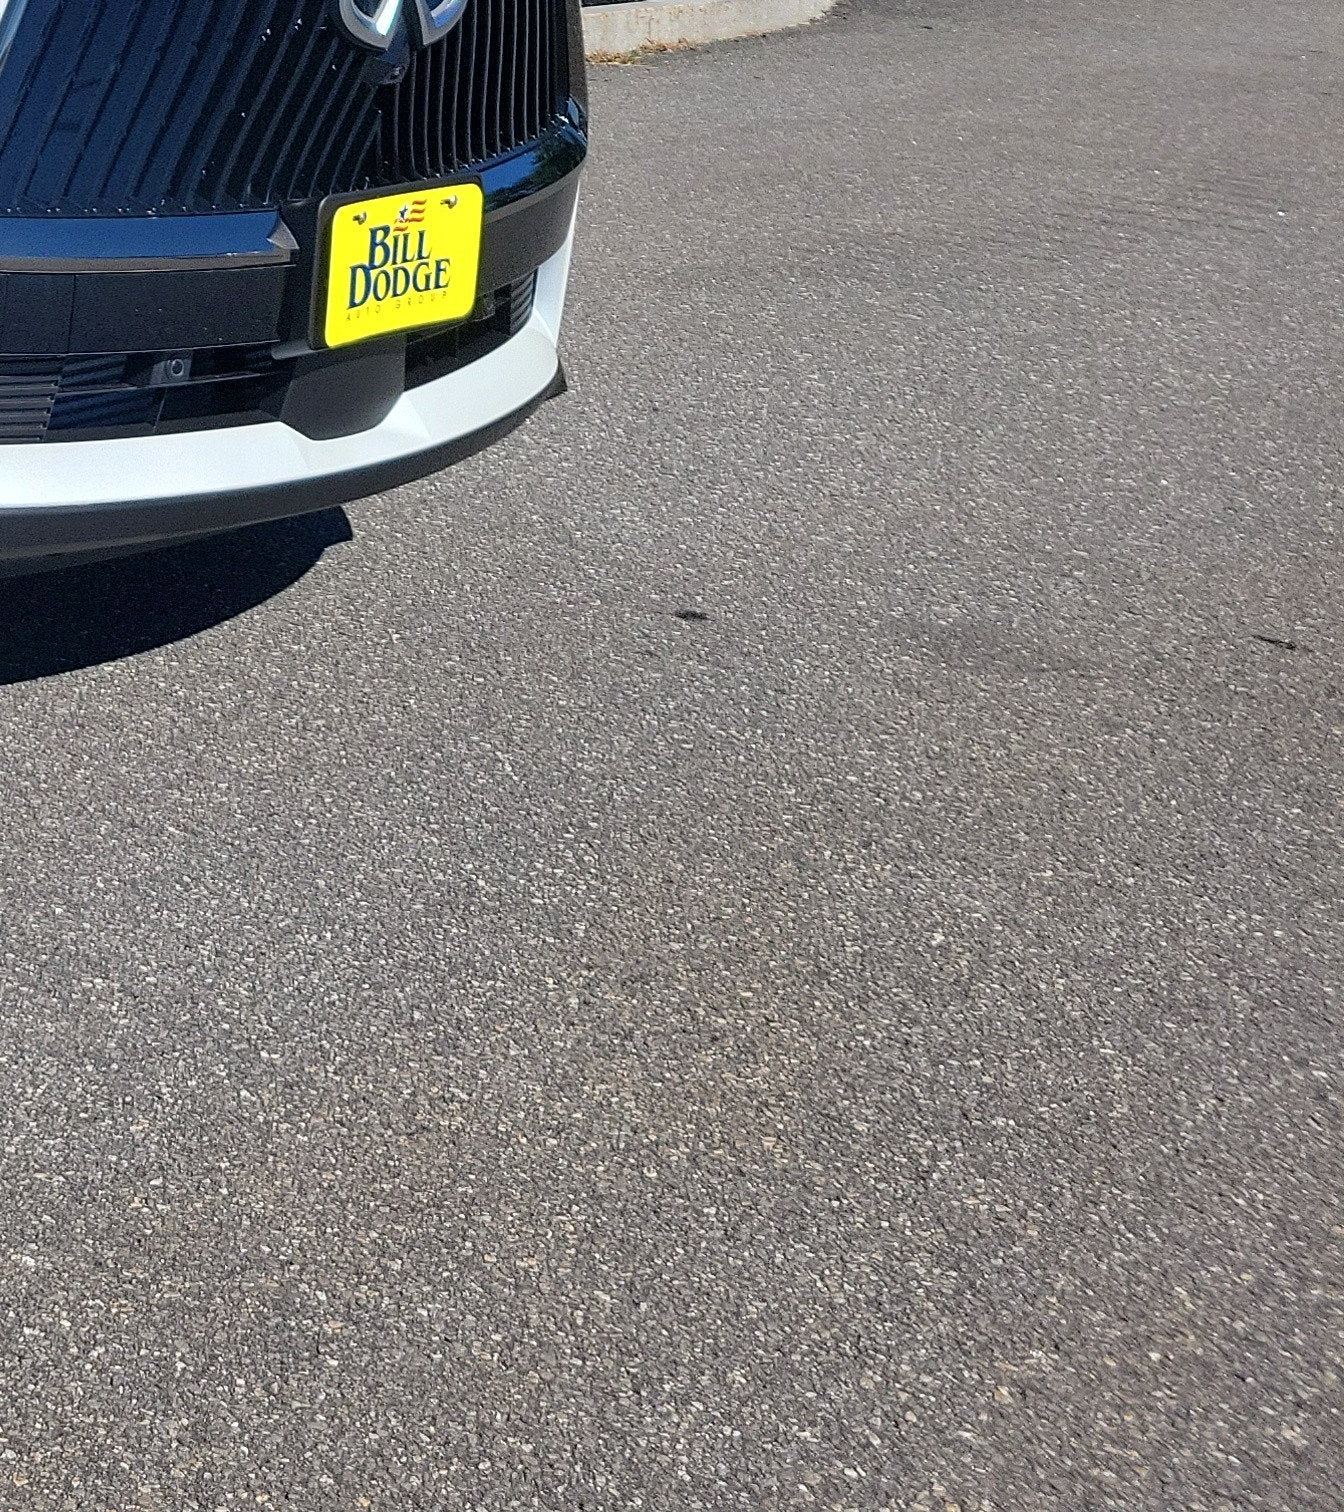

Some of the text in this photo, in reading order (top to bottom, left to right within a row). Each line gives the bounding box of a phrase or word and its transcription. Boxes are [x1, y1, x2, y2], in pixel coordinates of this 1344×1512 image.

[367, 223, 433, 270] BILL
[346, 258, 451, 310] DODGE
[346, 290, 448, 321] AUTO GROUP
